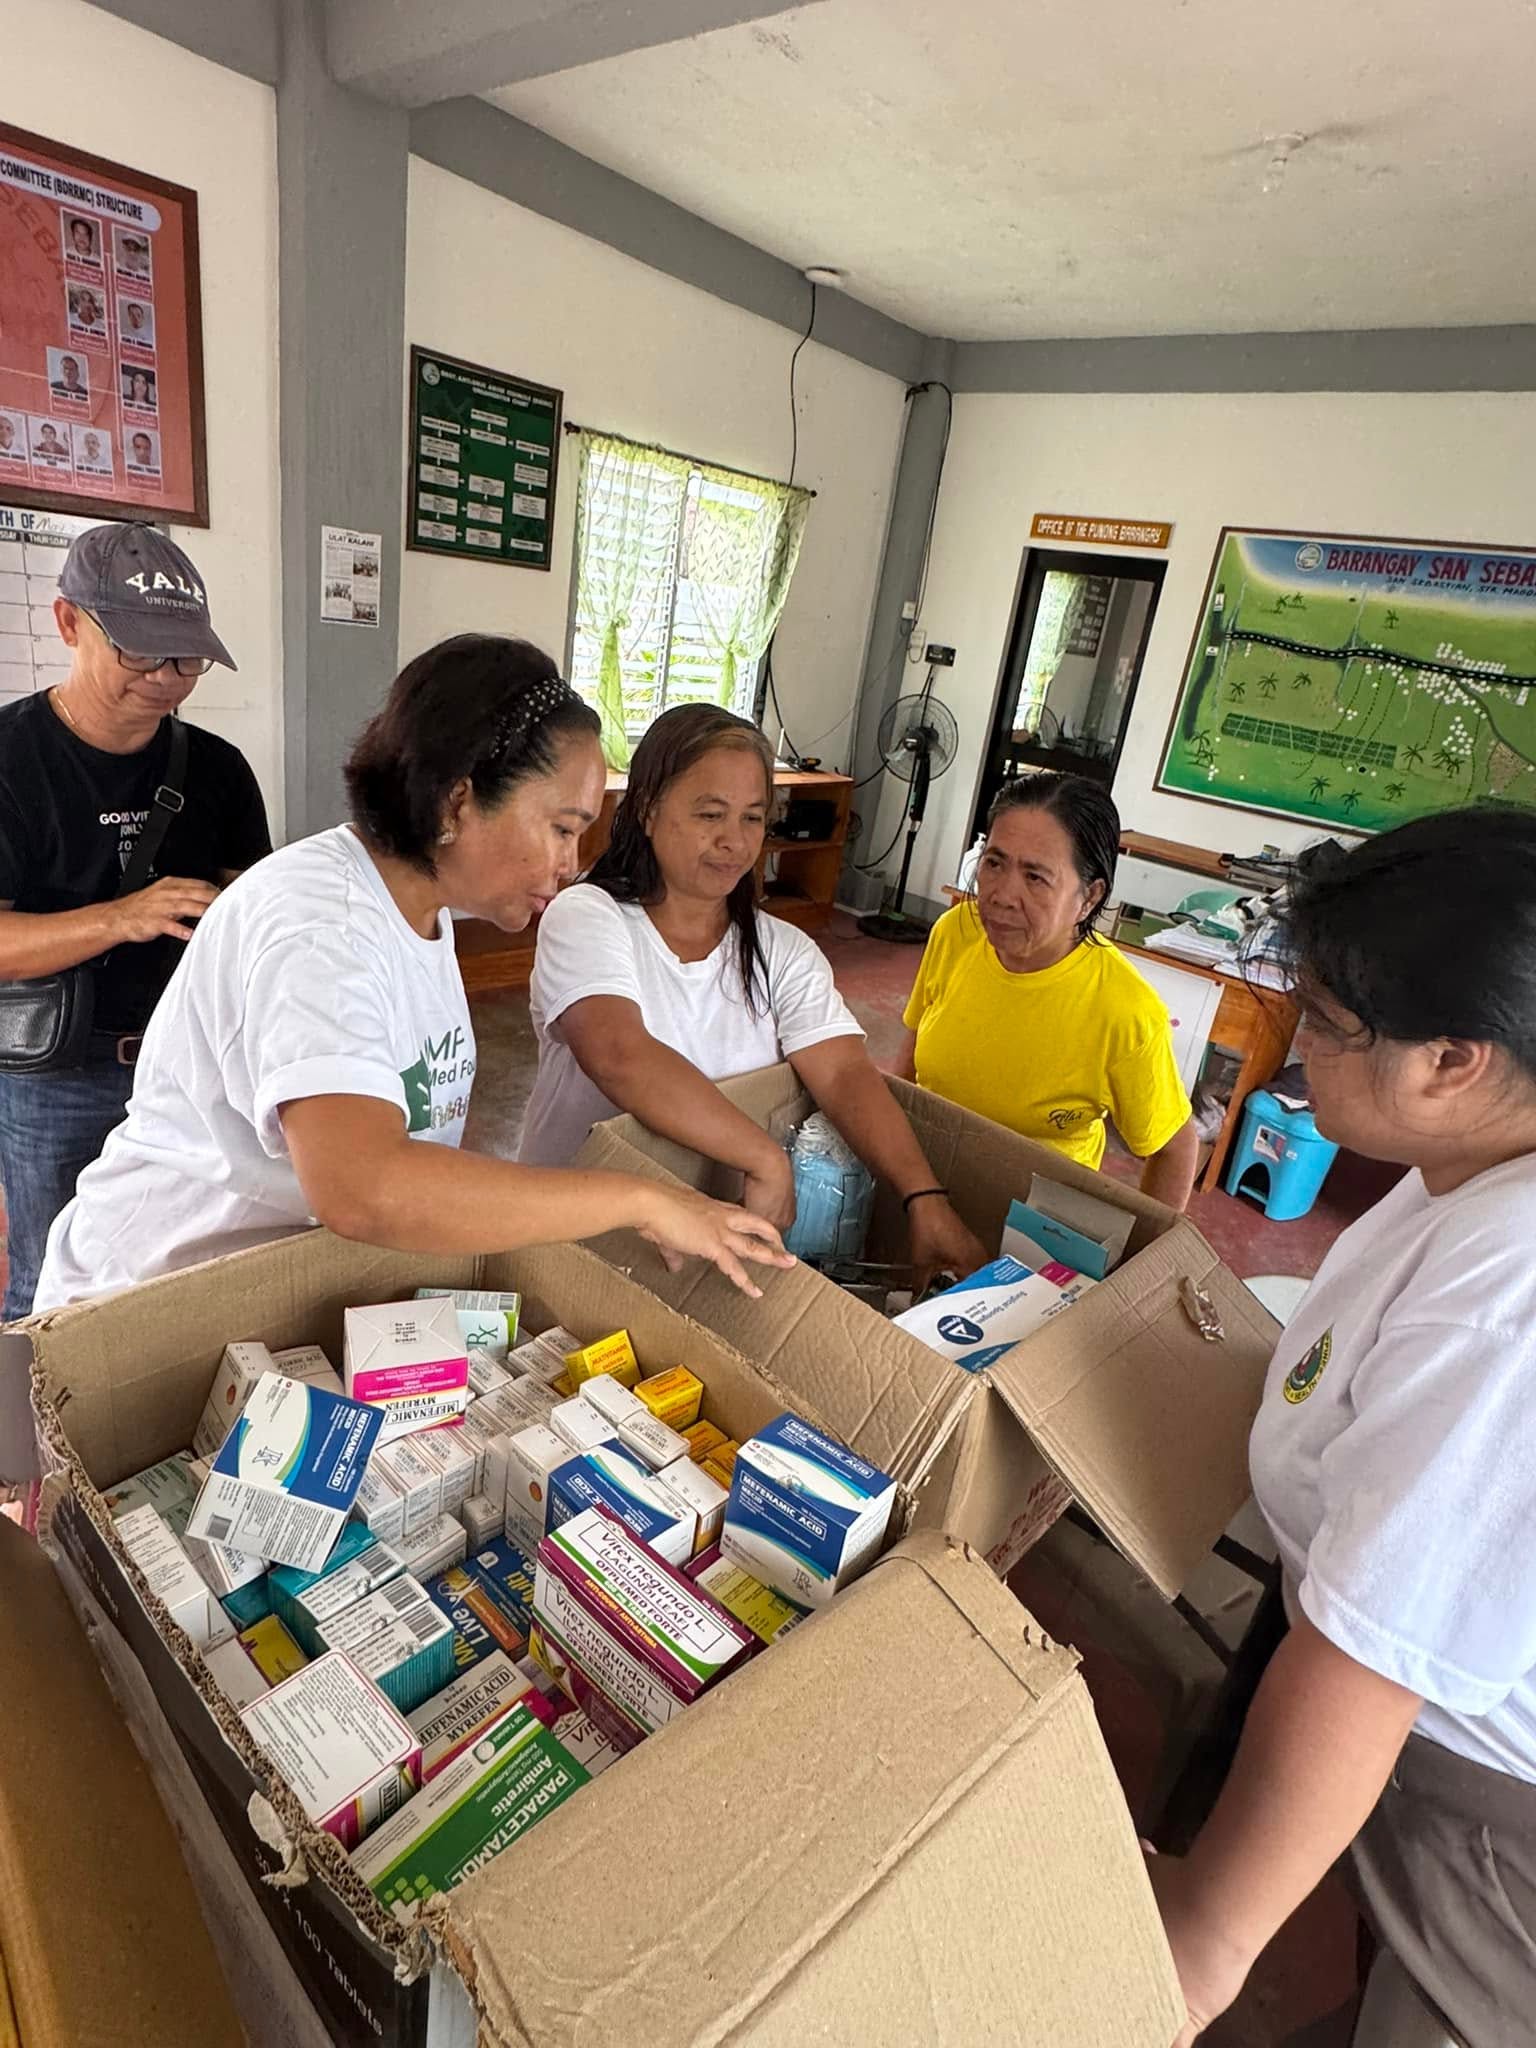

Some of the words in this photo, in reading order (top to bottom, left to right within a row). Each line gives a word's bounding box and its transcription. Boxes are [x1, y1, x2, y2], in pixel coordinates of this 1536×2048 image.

[1, 157, 53, 189] COMMITTEE
[95, 191, 143, 221] STRUCTURE
[21, 513, 35, 530] OF
[1037, 519, 1063, 536] OFFICE
[1075, 522, 1088, 537] THE
[126, 571, 204, 604] YALE
[1326, 549, 1420, 577] BARANGAY
[1428, 556, 1472, 581] SAN
[386, 1396, 437, 1410] MYREFEN
[391, 1403, 456, 1423] MEFENAMIC
[342, 1410, 369, 1468] MEFENAMIC
[790, 1421, 846, 1461] MEFENAMIC
[844, 1458, 871, 1477] ACID
[331, 1465, 348, 1488] ACID
[574, 1476, 595, 1495] ACID
[741, 1485, 763, 1504] MECID
[742, 1473, 796, 1517] MEFENAMIC
[799, 1516, 824, 1536] ACID
[600, 1547, 656, 1599] (LAGUNDI
[656, 1598, 691, 1631] LEAF)
[601, 1531, 635, 1565] Vitex
[636, 1562, 695, 1619] negundo
[595, 1559, 648, 1612] OFPLEMED
[648, 1609, 682, 1642] FORTE
[626, 1601, 653, 1626] TABLET
[452, 1607, 489, 1645] Live
[556, 1592, 585, 1629] Vitex
[587, 1627, 646, 1690] negundo
[562, 1615, 617, 1672] (LAGUNDI
[418, 1690, 488, 1747] MEFENAMIC
[485, 1671, 512, 1695] ACID
[446, 1698, 502, 1742] MYREFEN
[615, 1683, 650, 1718] FORTE
[491, 1755, 553, 1818] Ambiretic
[451, 1769, 569, 1884] PARACETAMOL
[296, 1909, 321, 1953] 100
[325, 1948, 382, 2036] Tablets
